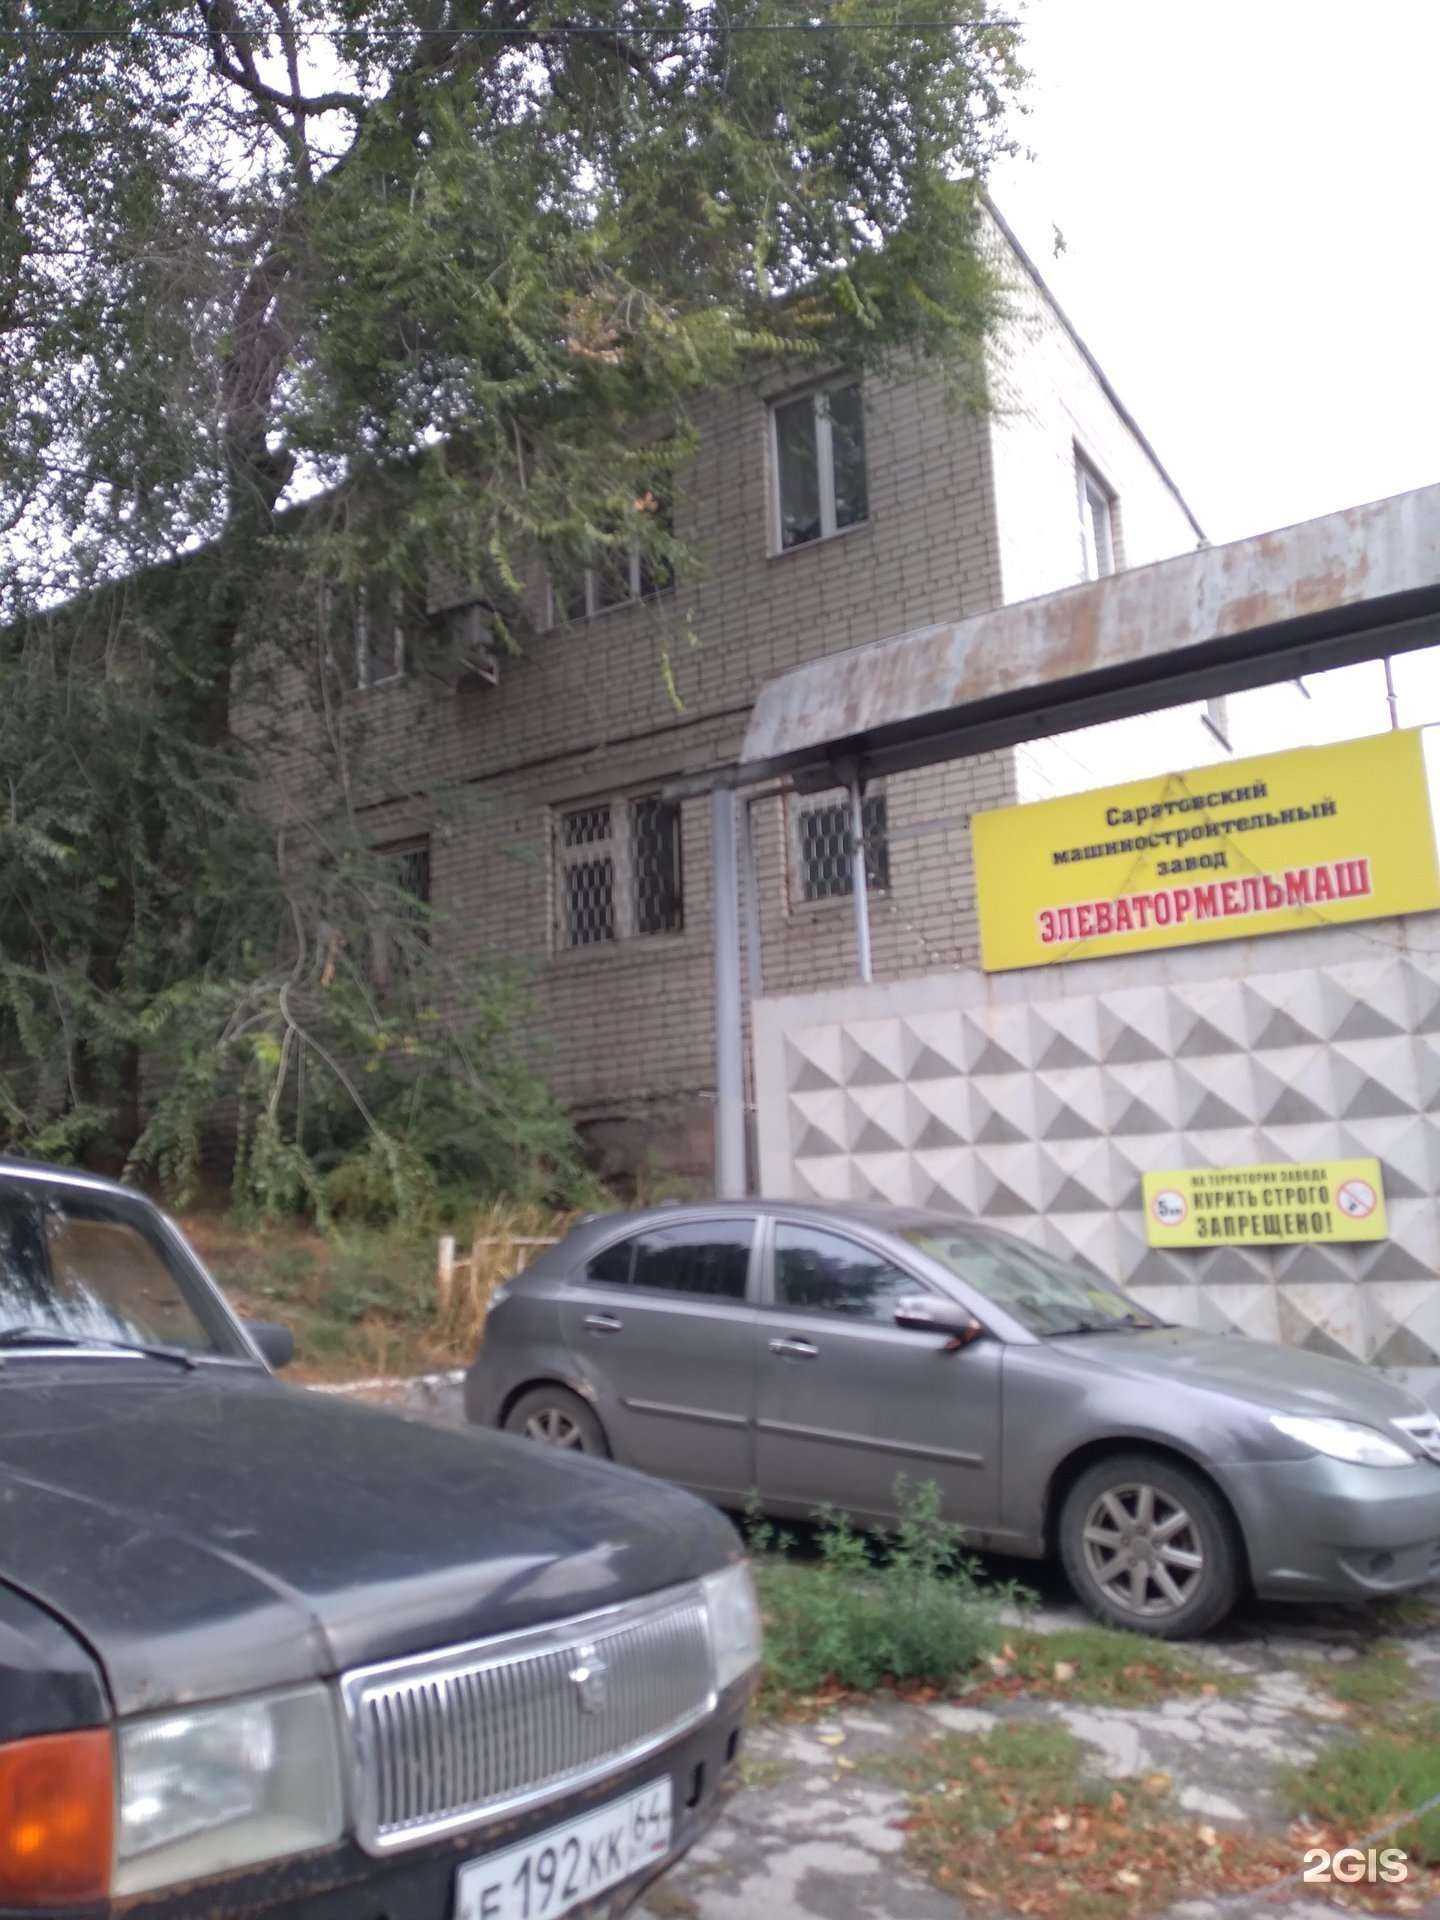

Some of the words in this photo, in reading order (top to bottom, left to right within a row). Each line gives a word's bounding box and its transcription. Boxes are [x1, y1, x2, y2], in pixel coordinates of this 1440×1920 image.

[1105, 779, 1268, 827] Саратовский
[1052, 796, 1337, 866] машиностроительный
[1156, 849, 1227, 877] завод
[1040, 859, 1369, 942] ЭЛЕВАТОРМЕЛЬМАШ
[1281, 1169, 1327, 1182] ЗАВОДА
[1193, 1190, 1258, 1210] КУРИТЬ
[1263, 1185, 1329, 1206] СТРОГО
[1197, 1211, 1333, 1239] ЗАПРЕЩЕНО!
